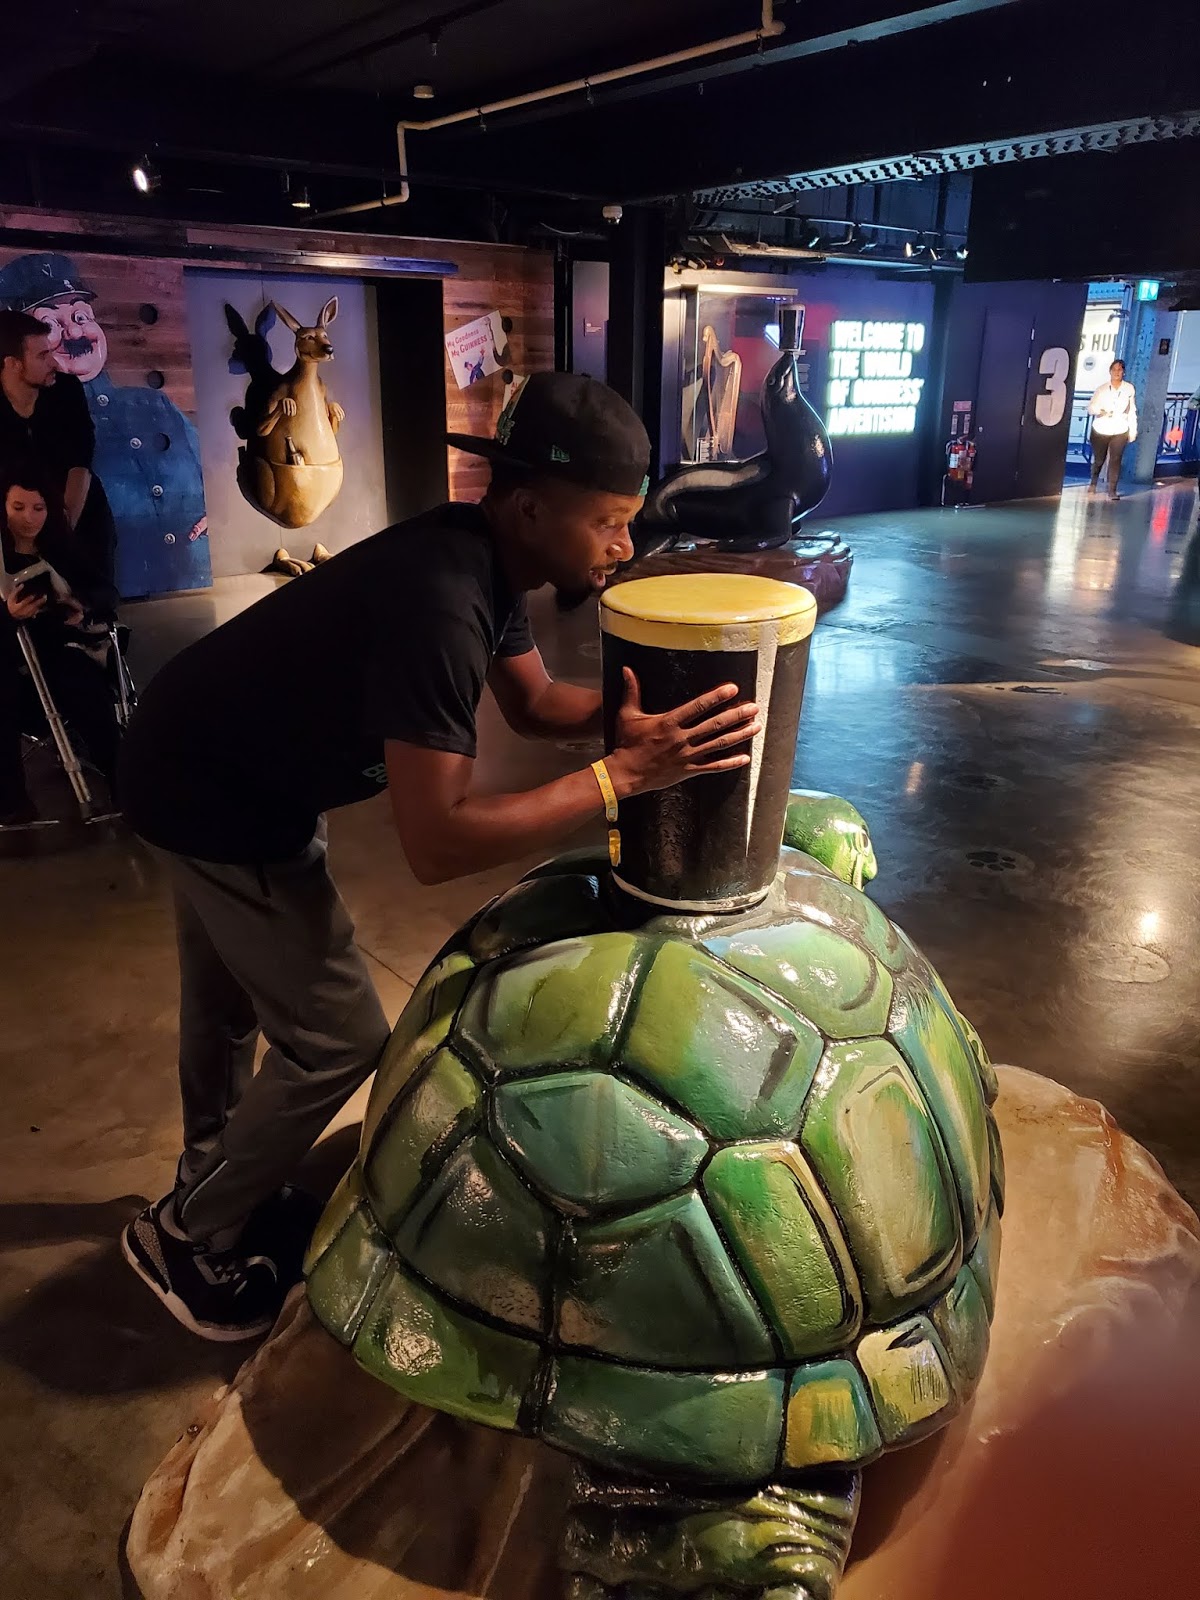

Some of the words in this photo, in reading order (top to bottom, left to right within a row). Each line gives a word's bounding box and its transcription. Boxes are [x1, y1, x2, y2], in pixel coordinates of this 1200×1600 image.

[455, 328, 480, 344] Goodness
[459, 334, 488, 354] GUINNESS
[832, 320, 905, 350] WELCOME
[907, 322, 925, 352] TO
[830, 350, 860, 378] THE
[1035, 347, 1070, 427] 3
